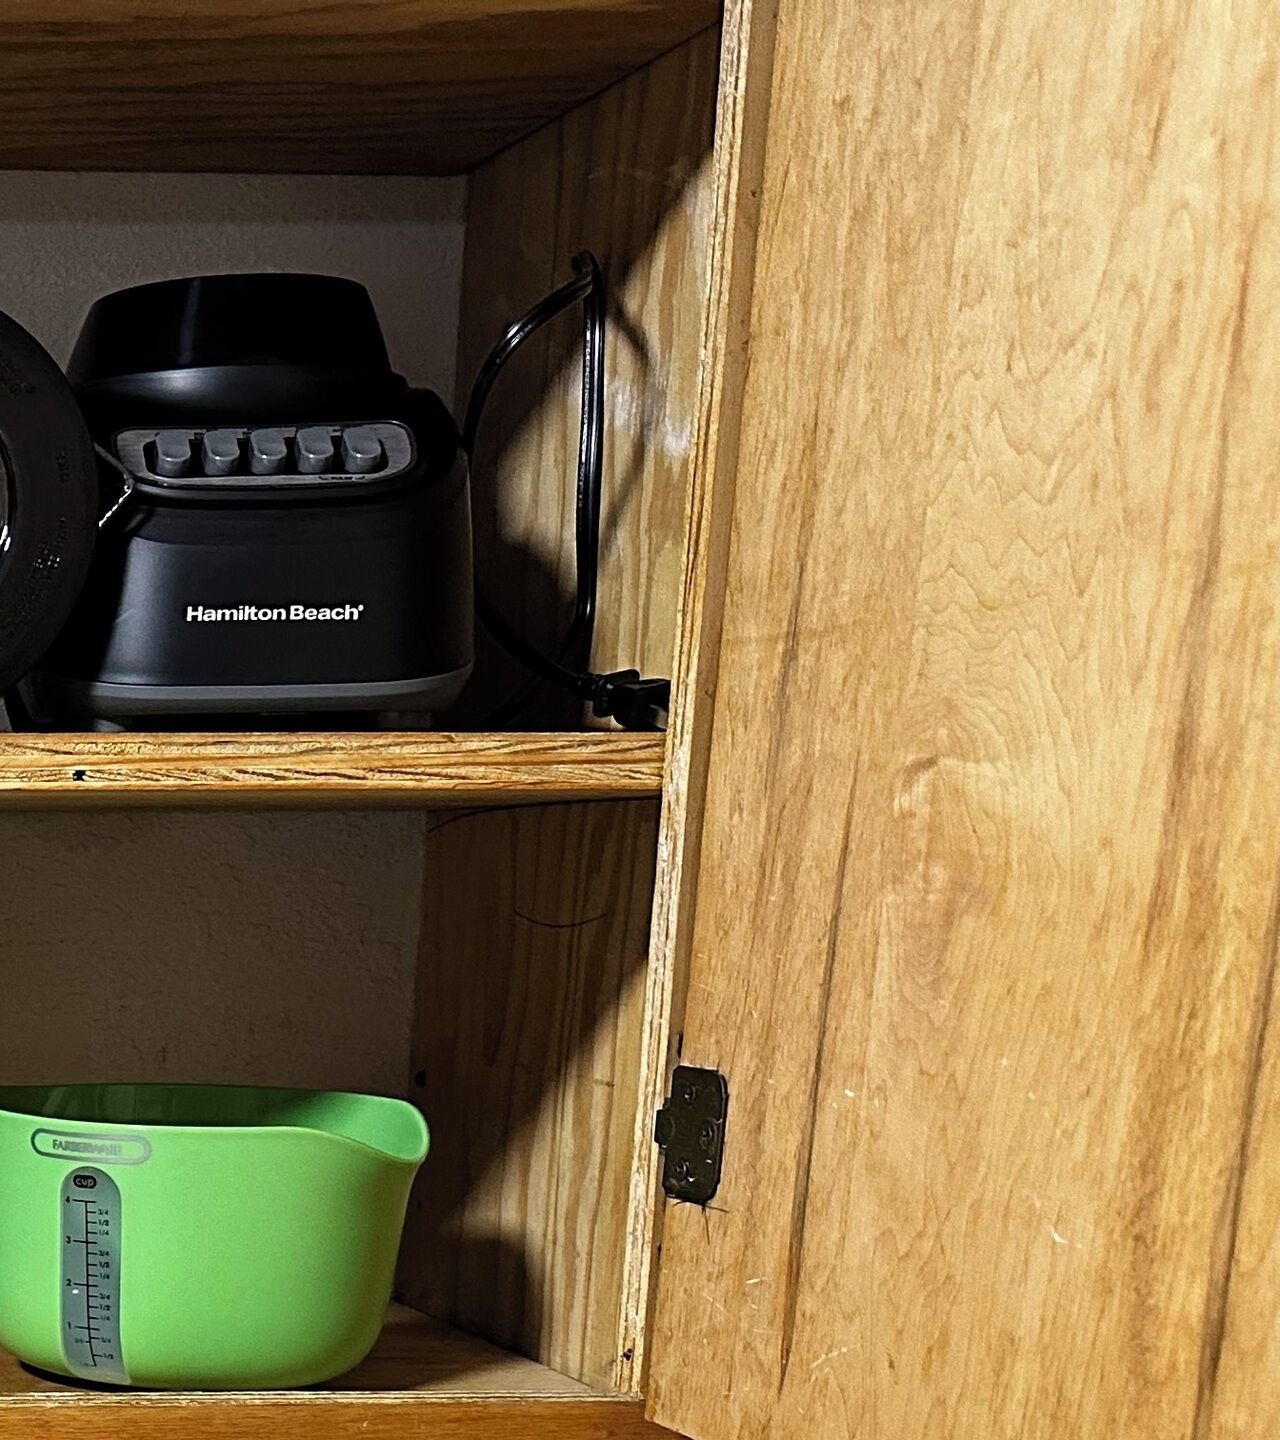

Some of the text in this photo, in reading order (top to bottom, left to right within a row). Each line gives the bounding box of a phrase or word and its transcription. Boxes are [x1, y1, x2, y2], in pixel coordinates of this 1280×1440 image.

[186, 605, 287, 621] Hamilton
[75, 1177, 94, 1188] cup
[65, 1278, 72, 1287] 2
